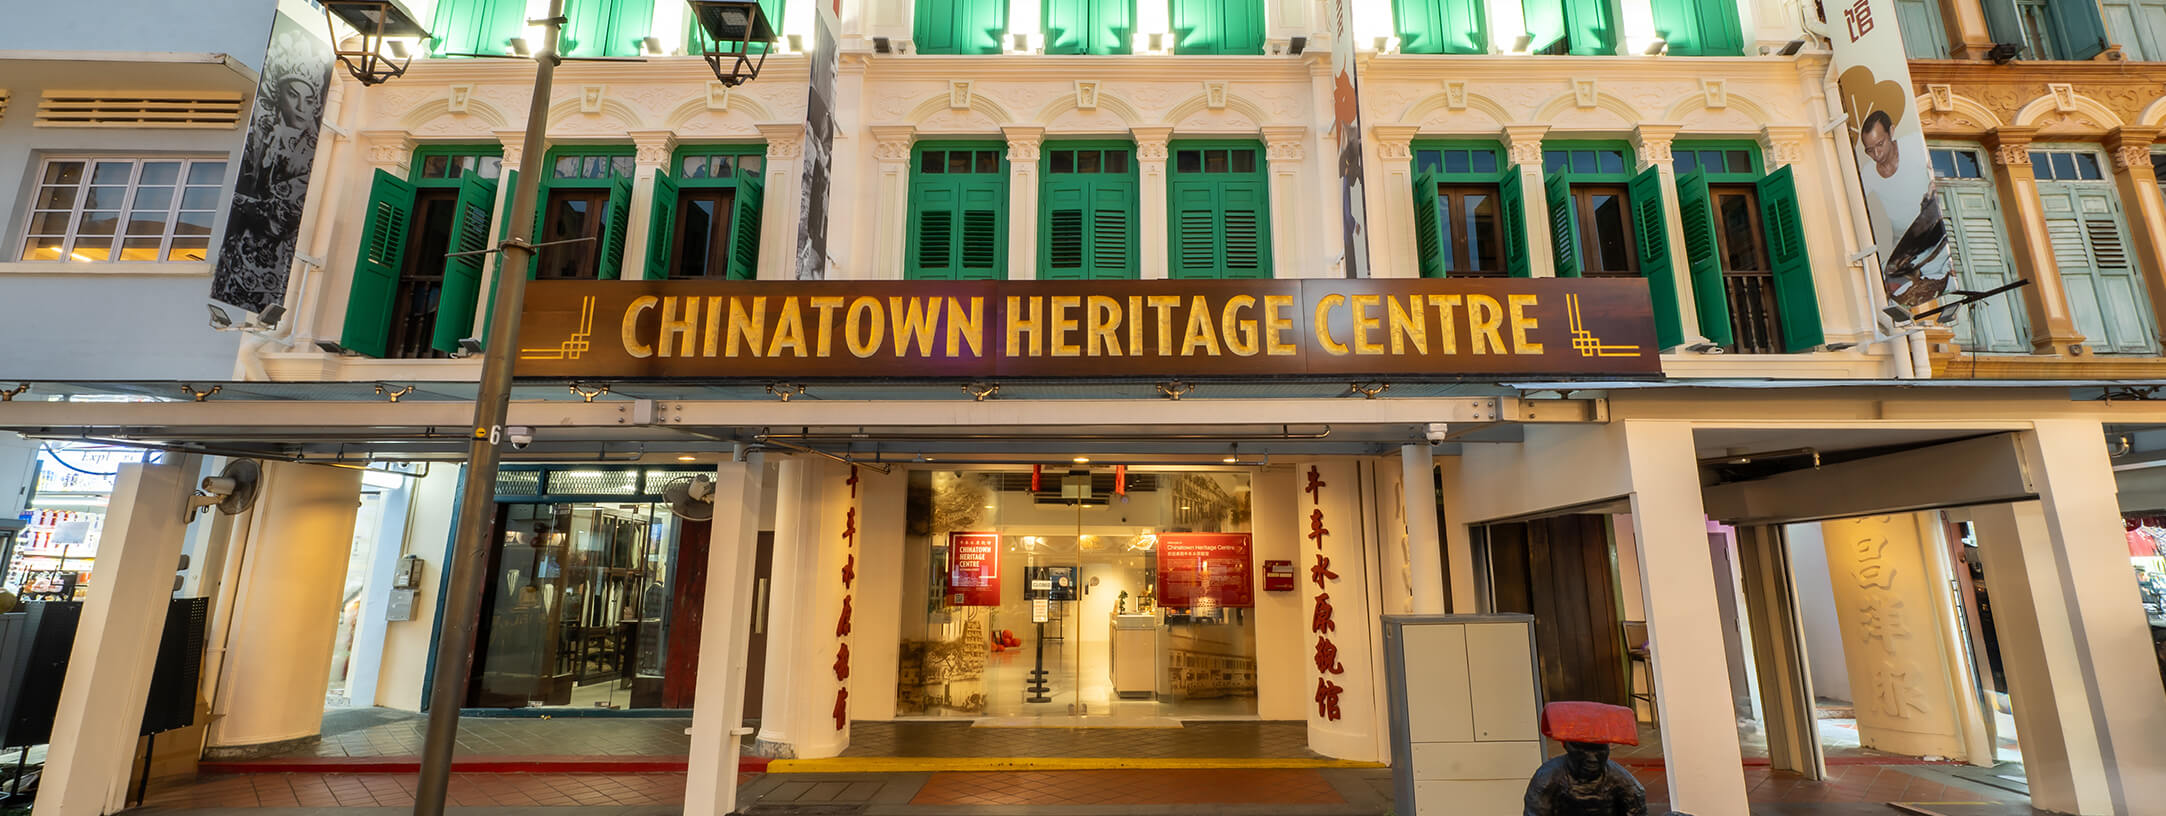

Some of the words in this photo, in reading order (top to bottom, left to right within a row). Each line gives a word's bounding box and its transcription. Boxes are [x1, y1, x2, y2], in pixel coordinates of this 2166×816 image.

[621, 294, 984, 359] CHINATOWN
[1006, 294, 1297, 358] HERITAGE
[1314, 293, 1544, 357] CENTRE
[489, 424, 502, 446] 6
